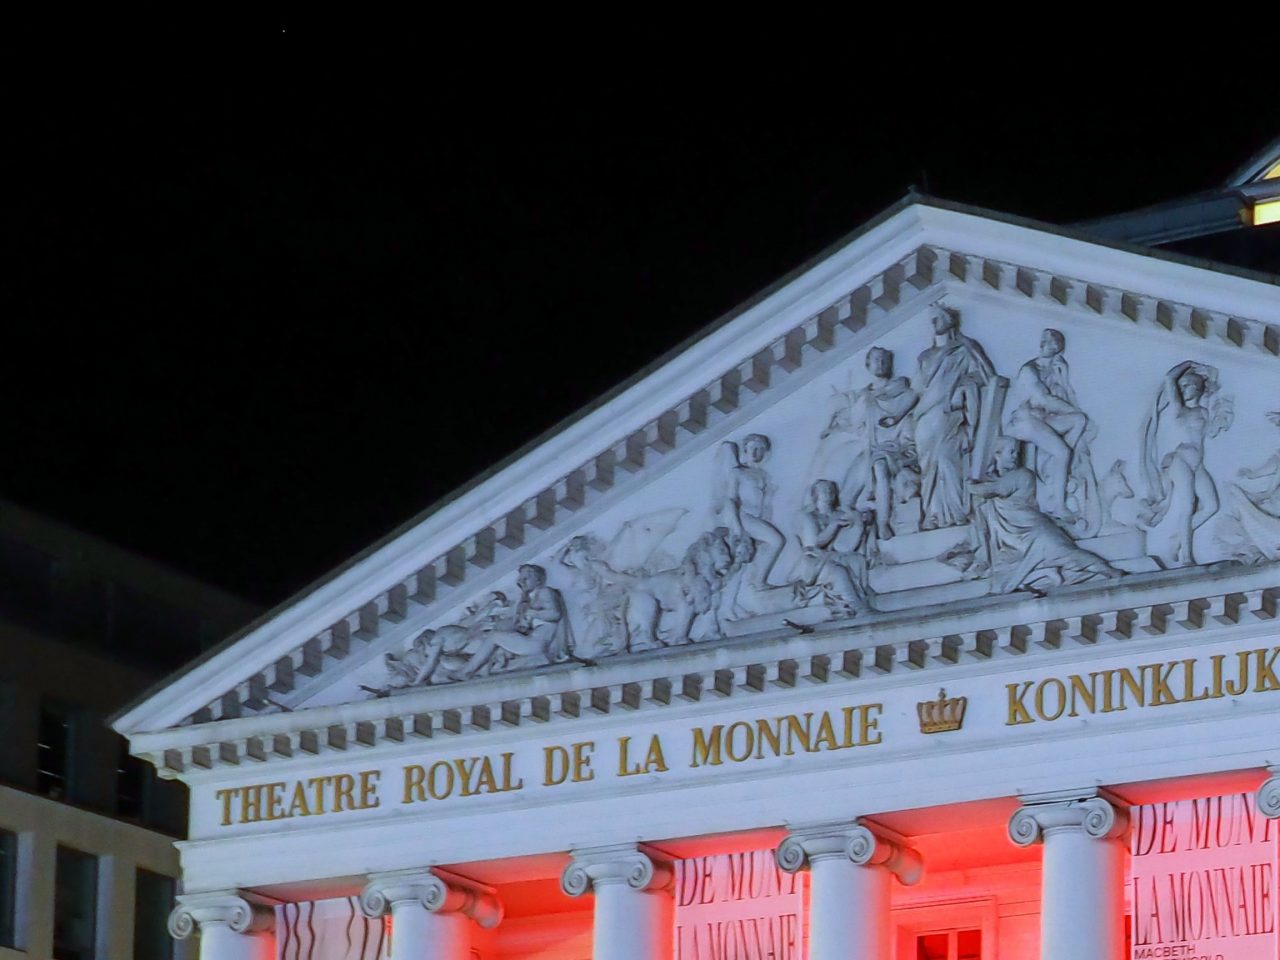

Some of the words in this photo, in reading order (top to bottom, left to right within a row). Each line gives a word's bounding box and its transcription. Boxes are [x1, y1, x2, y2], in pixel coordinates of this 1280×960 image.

[216, 770, 382, 826] THEATRE
[402, 752, 523, 803] ROYAL
[543, 741, 594, 787] DE
[616, 734, 670, 777] LA
[690, 703, 883, 768] MONNAIE
[1134, 803, 1178, 857] DE
[678, 857, 715, 907] DE
[1134, 875, 1163, 946] LA
[1168, 863, 1274, 943] MONNAIE
[1134, 945, 1196, 959] MACBETH
